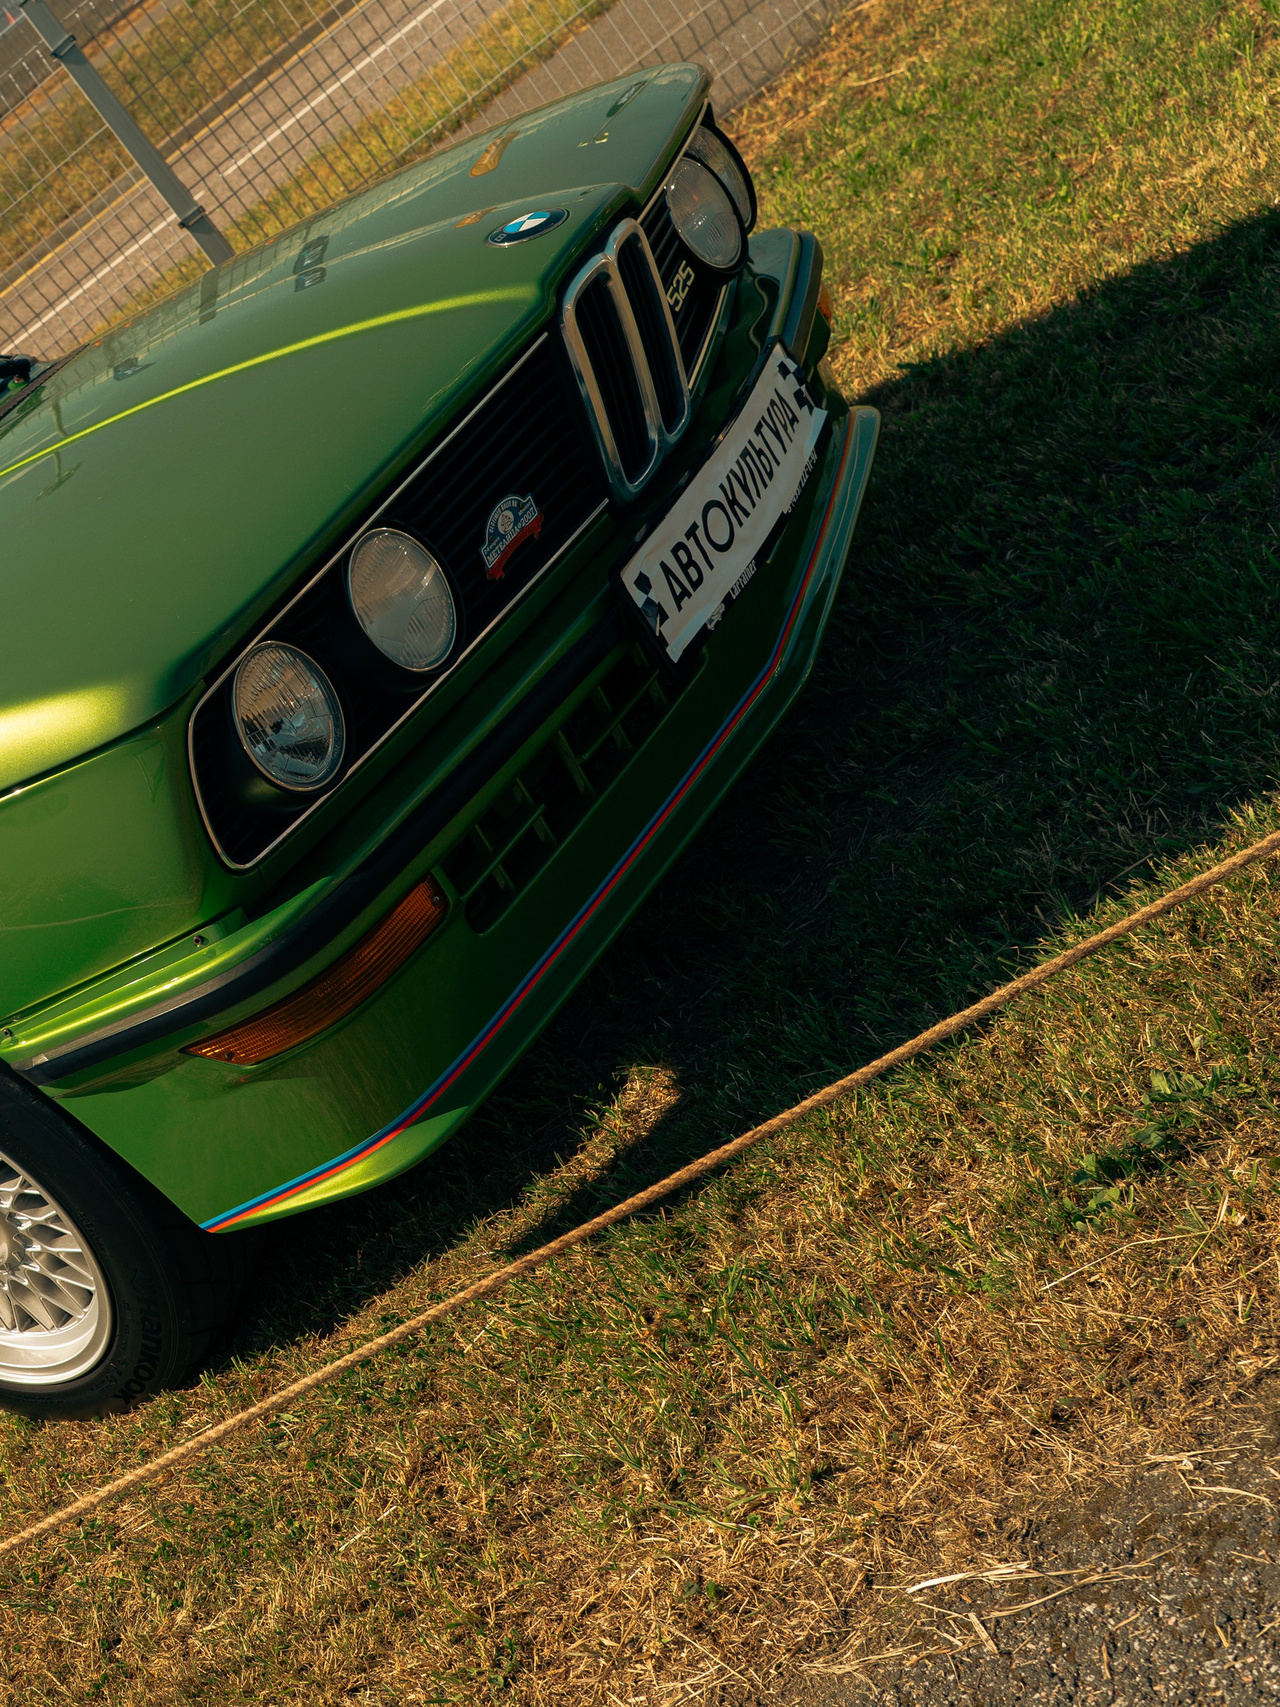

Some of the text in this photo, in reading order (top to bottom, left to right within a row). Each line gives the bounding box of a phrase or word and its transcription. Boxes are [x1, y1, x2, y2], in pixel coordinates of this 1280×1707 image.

[667, 260, 695, 312] 525
[521, 506, 535, 527] 2007
[659, 388, 800, 612] АВТОКУЛЬТУРА
